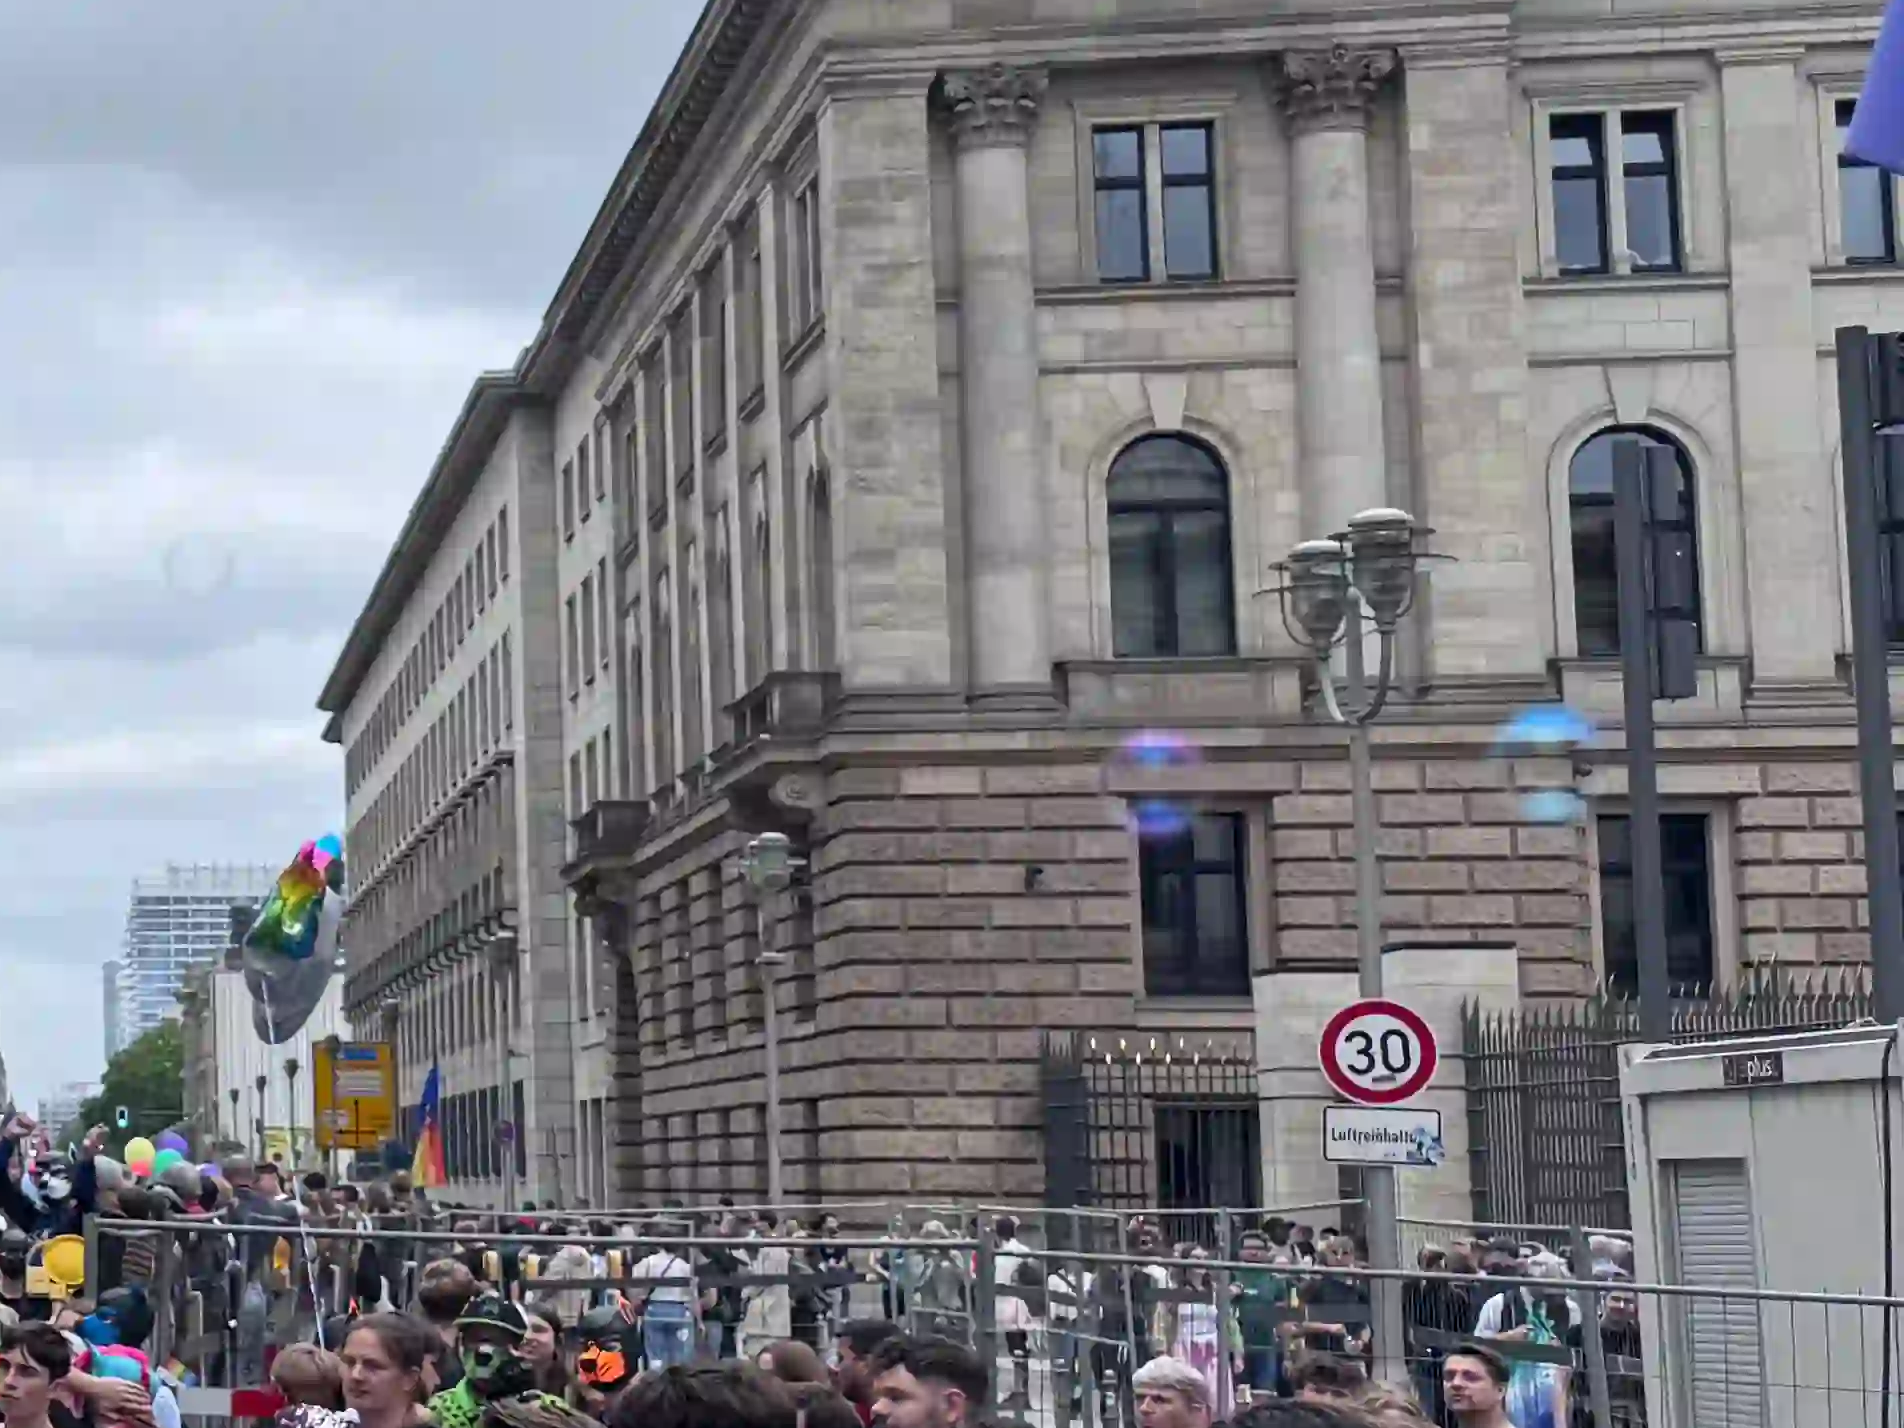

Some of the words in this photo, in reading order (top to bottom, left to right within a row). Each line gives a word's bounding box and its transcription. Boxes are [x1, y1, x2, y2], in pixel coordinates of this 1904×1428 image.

[1343, 1028, 1412, 1075] 30
[1747, 1055, 1774, 1083] plus
[1331, 1127, 1417, 1144] Luftreinhaltu
